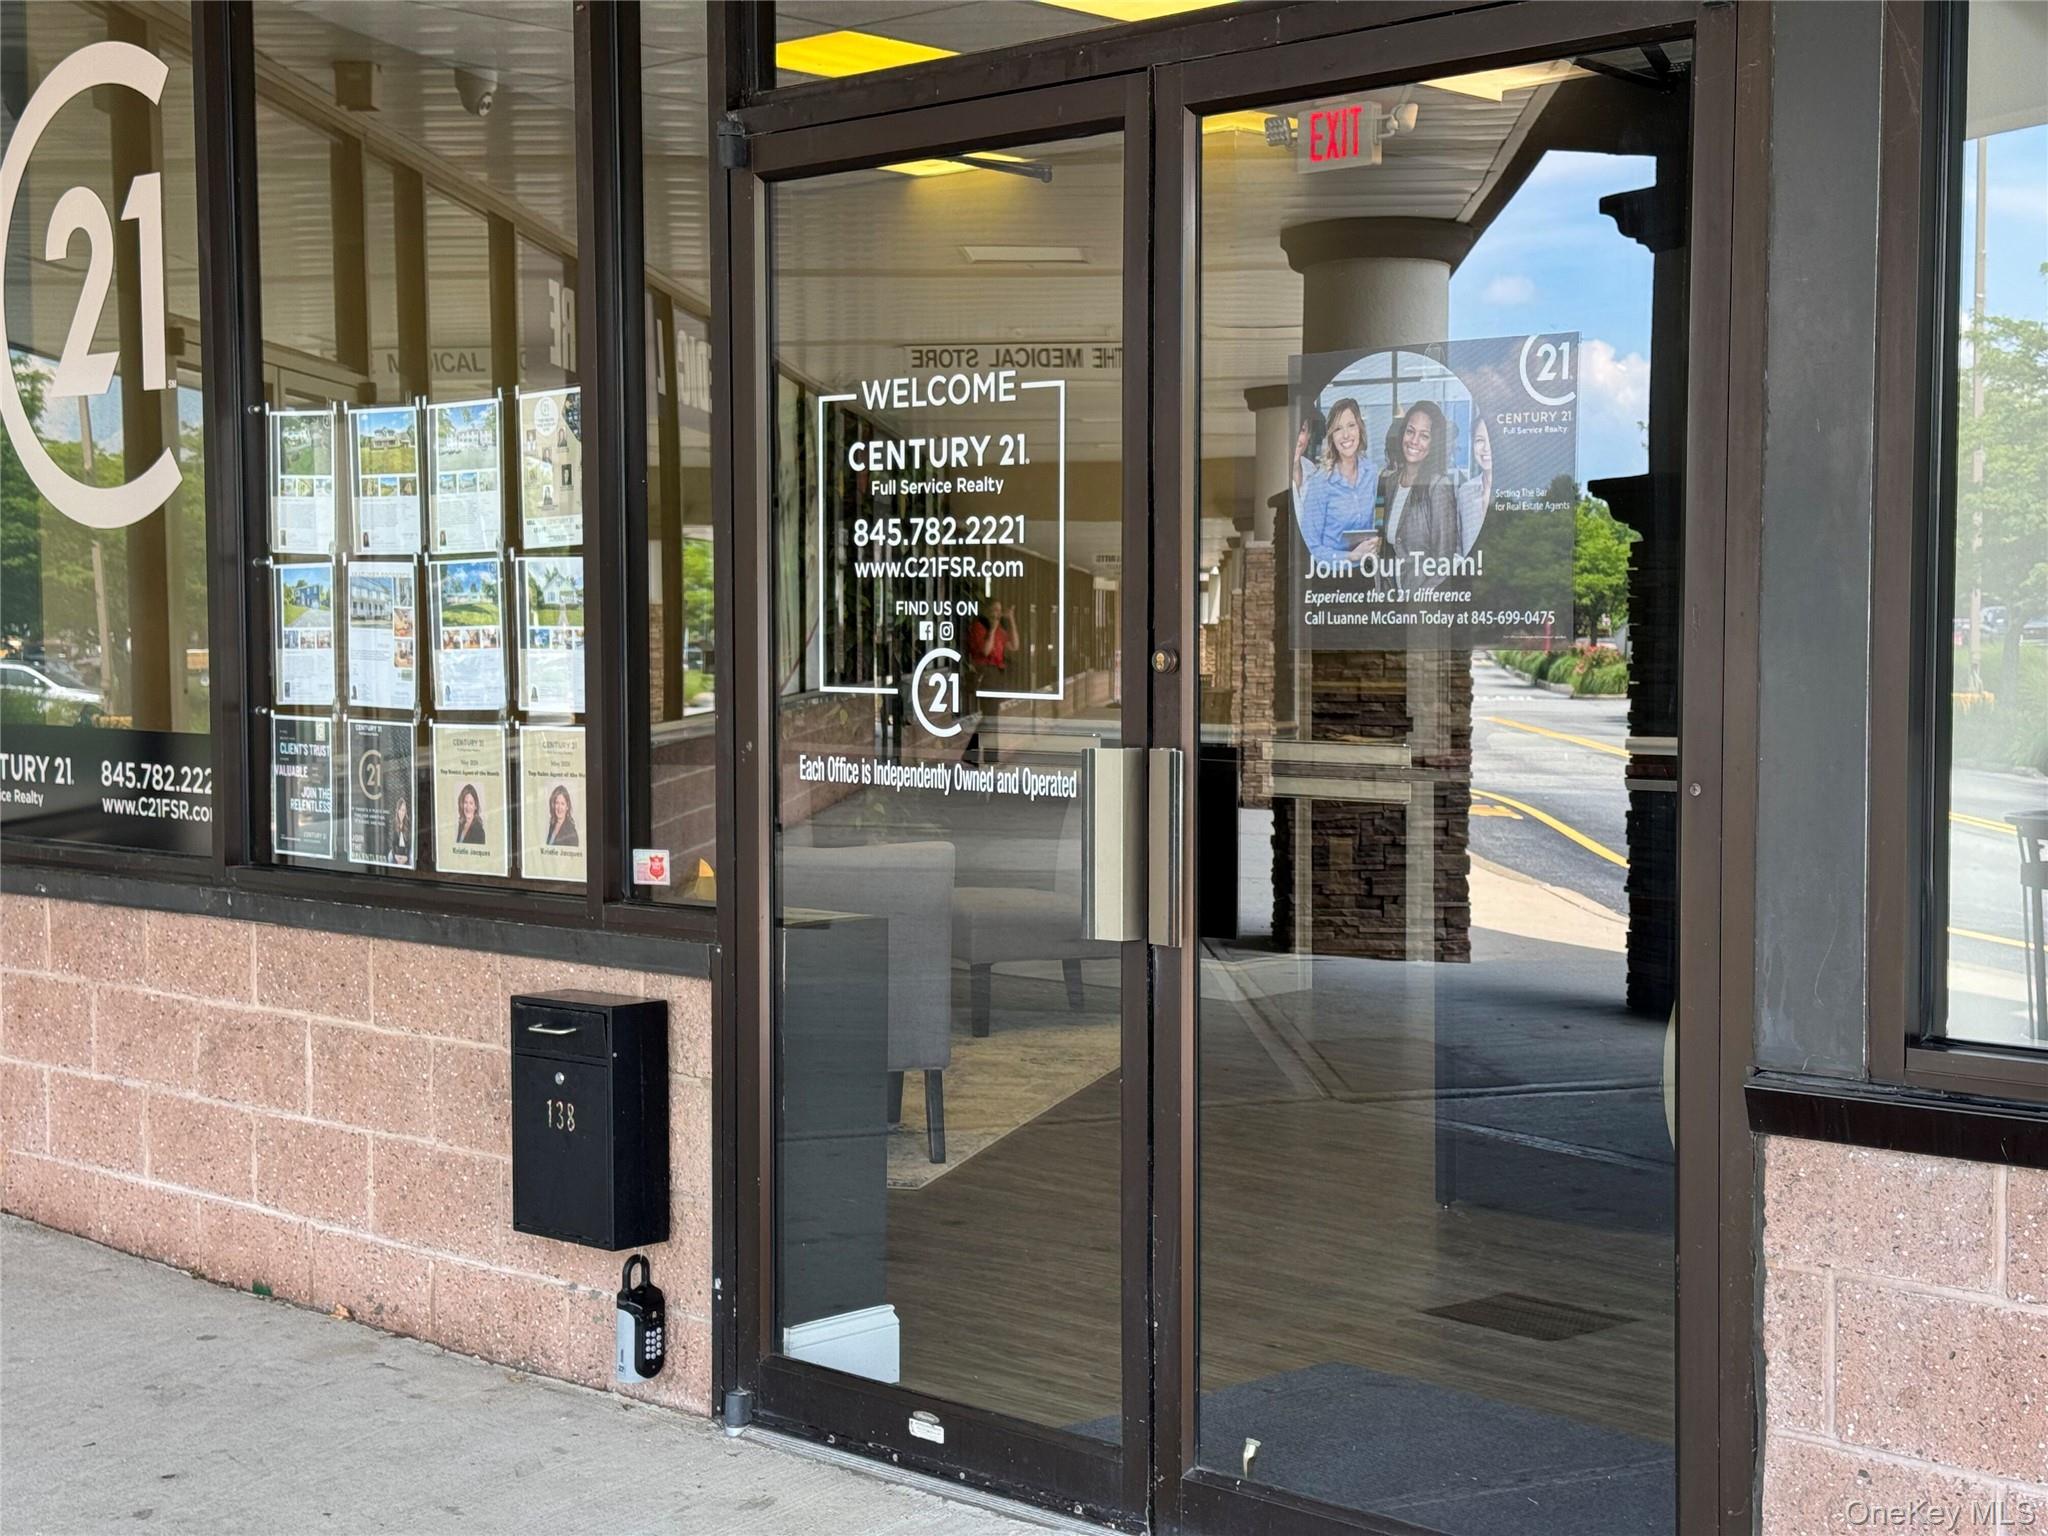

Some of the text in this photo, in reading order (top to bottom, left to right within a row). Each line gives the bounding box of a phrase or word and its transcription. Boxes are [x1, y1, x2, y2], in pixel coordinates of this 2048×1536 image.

[1310, 105, 1363, 162] EXIT
[862, 370, 1016, 410] WELCOME
[1497, 410, 1572, 424] CENTURY 21
[1517, 426, 1542, 434] Service
[1544, 425, 1568, 434] Realty
[848, 435, 991, 471] CENTURY
[872, 476, 1004, 496] Full Service Realty
[1496, 488, 1548, 499] Setting The Bar
[1495, 501, 1570, 512] for Real Estate Agents
[854, 515, 1025, 547] 845.782.2221
[854, 556, 1024, 578] www.C21FSR.com
[1305, 550, 1482, 579] Join Our Team!
[1305, 590, 1364, 607] Experience
[1366, 588, 1385, 602] the
[1414, 587, 1472, 602] difference
[896, 601, 979, 616] FIND US ON
[1304, 610, 1555, 628] Call Luanne McGann Today at 845-699-0475
[280, 742, 308, 757] CLIENT'S
[800, 754, 1078, 801] Each Office is Independently Owned and Operated
[14, 789, 44, 807] Realty
[301, 786, 317, 799] JOIN
[102, 796, 212, 822] www.C21FSR.co
[546, 1100, 575, 1132] 138
